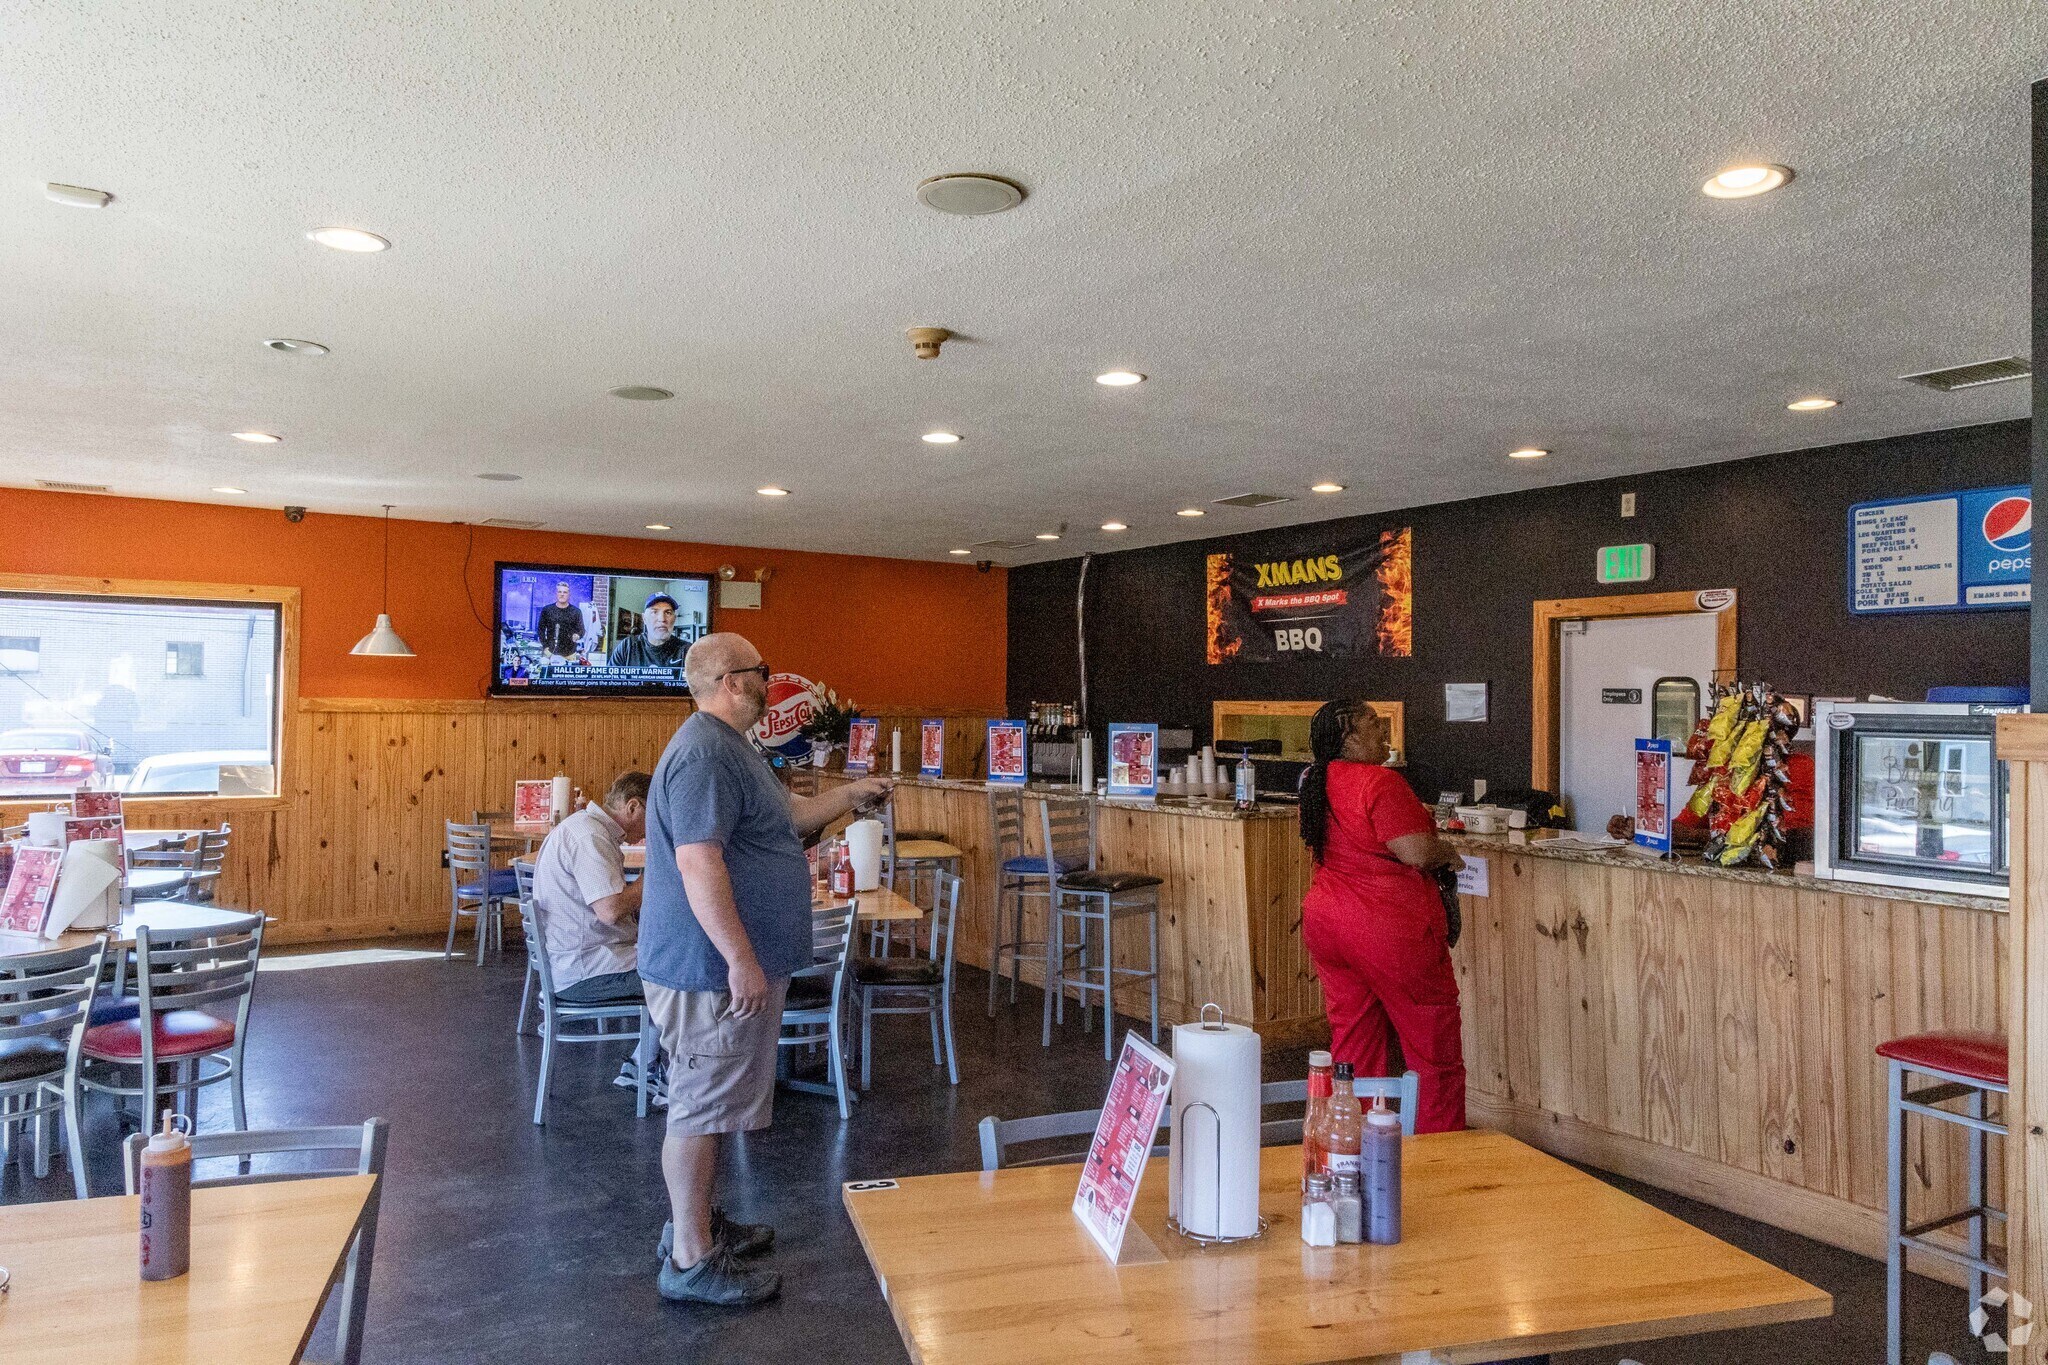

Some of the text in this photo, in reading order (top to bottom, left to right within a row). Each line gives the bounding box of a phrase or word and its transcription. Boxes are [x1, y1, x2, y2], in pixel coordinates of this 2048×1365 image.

[1871, 528, 1906, 537] QUARTERS
[1605, 545, 1644, 580] EXIT
[1988, 557, 2032, 574] peps
[1253, 554, 1343, 588] XMANS
[1257, 593, 1340, 607] X Marks the BBQ Spot
[1973, 591, 2000, 599] XMANS
[1883, 598, 1895, 606] BY
[1899, 597, 1909, 605] LB
[1274, 627, 1323, 652] BBQ
[553, 666, 574, 675] HALL
[574, 666, 585, 675] OF
[586, 667, 608, 675] FAME
[608, 667, 619, 676] QB
[641, 668, 673, 676] WARNER
[585, 680, 599, 688] joins
[1462, 815, 1480, 827] TIPS
[1467, 865, 1479, 874] Ring
[1465, 873, 1475, 881] For
[1458, 882, 1474, 890] ervice
[1336, 1159, 1361, 1171] FRANK
